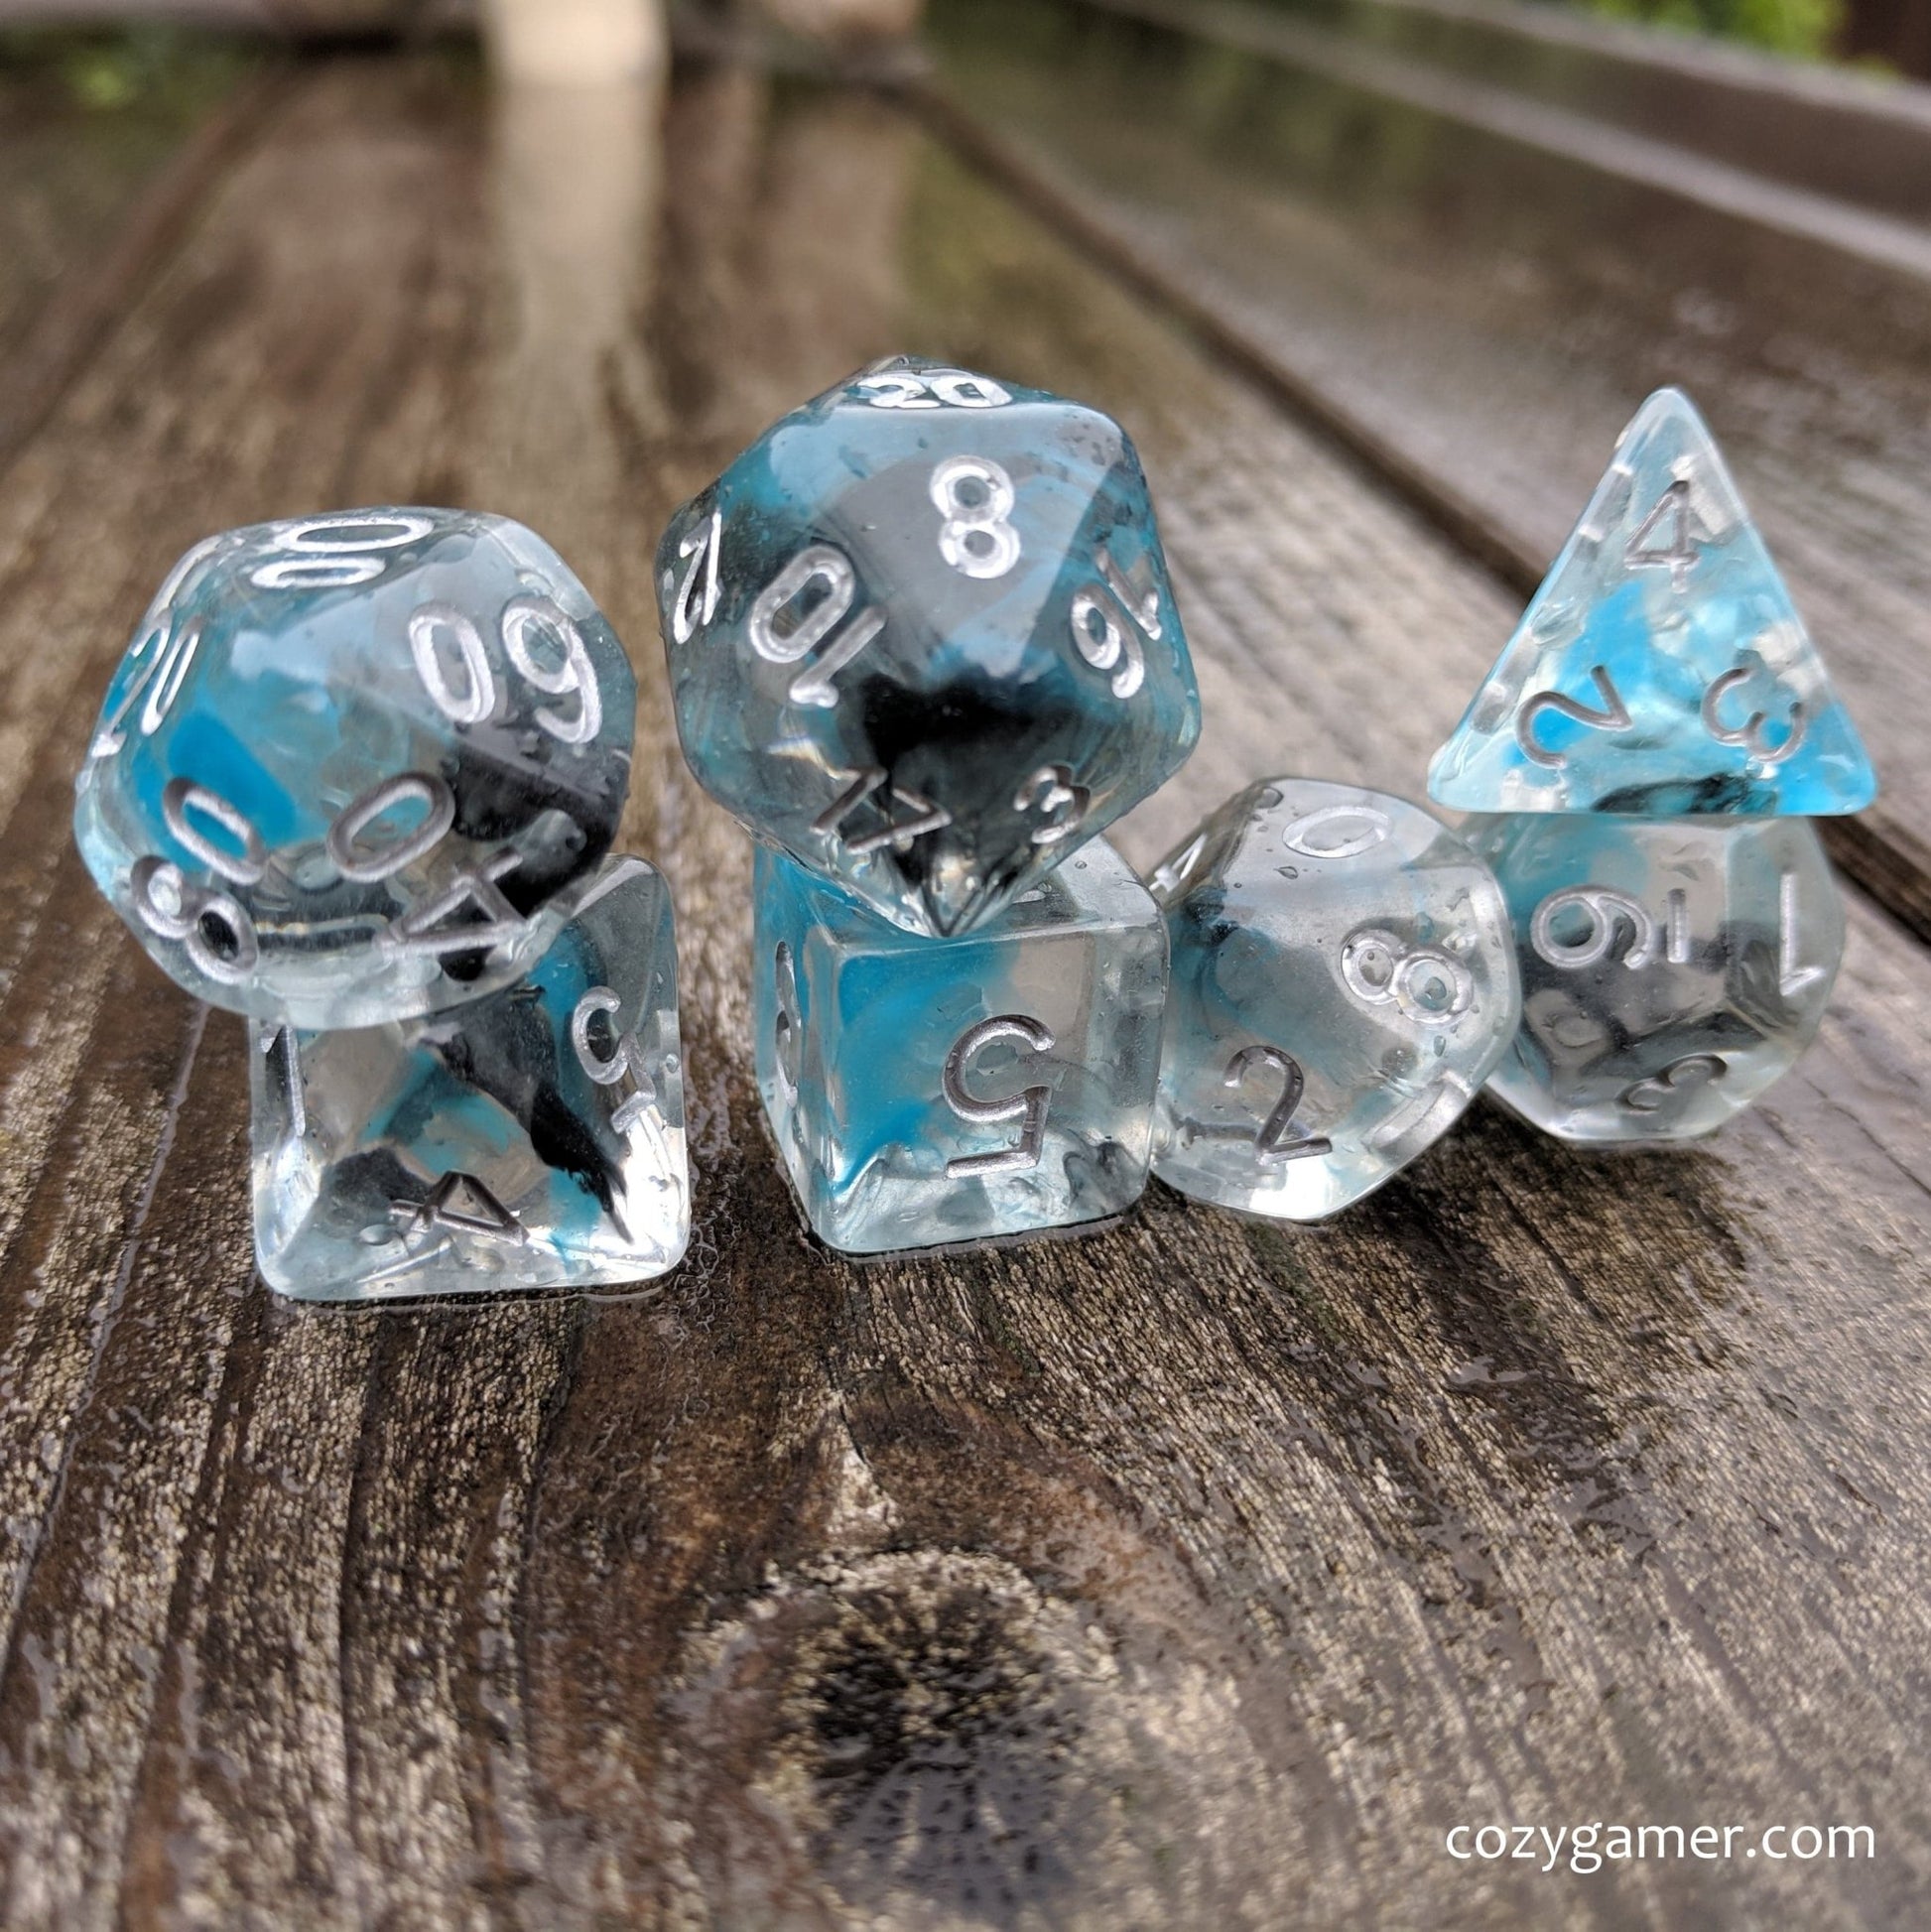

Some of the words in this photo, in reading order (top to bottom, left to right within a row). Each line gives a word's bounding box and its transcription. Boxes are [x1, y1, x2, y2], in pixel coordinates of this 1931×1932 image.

[857, 369, 1013, 409] 20
[929, 455, 1021, 579] 8
[1624, 480, 1700, 593] 4
[1700, 668, 1806, 763] 3
[1341, 927, 1476, 1026] 8
[943, 1014, 1056, 1179] 5
[1223, 1045, 1333, 1165] 2
